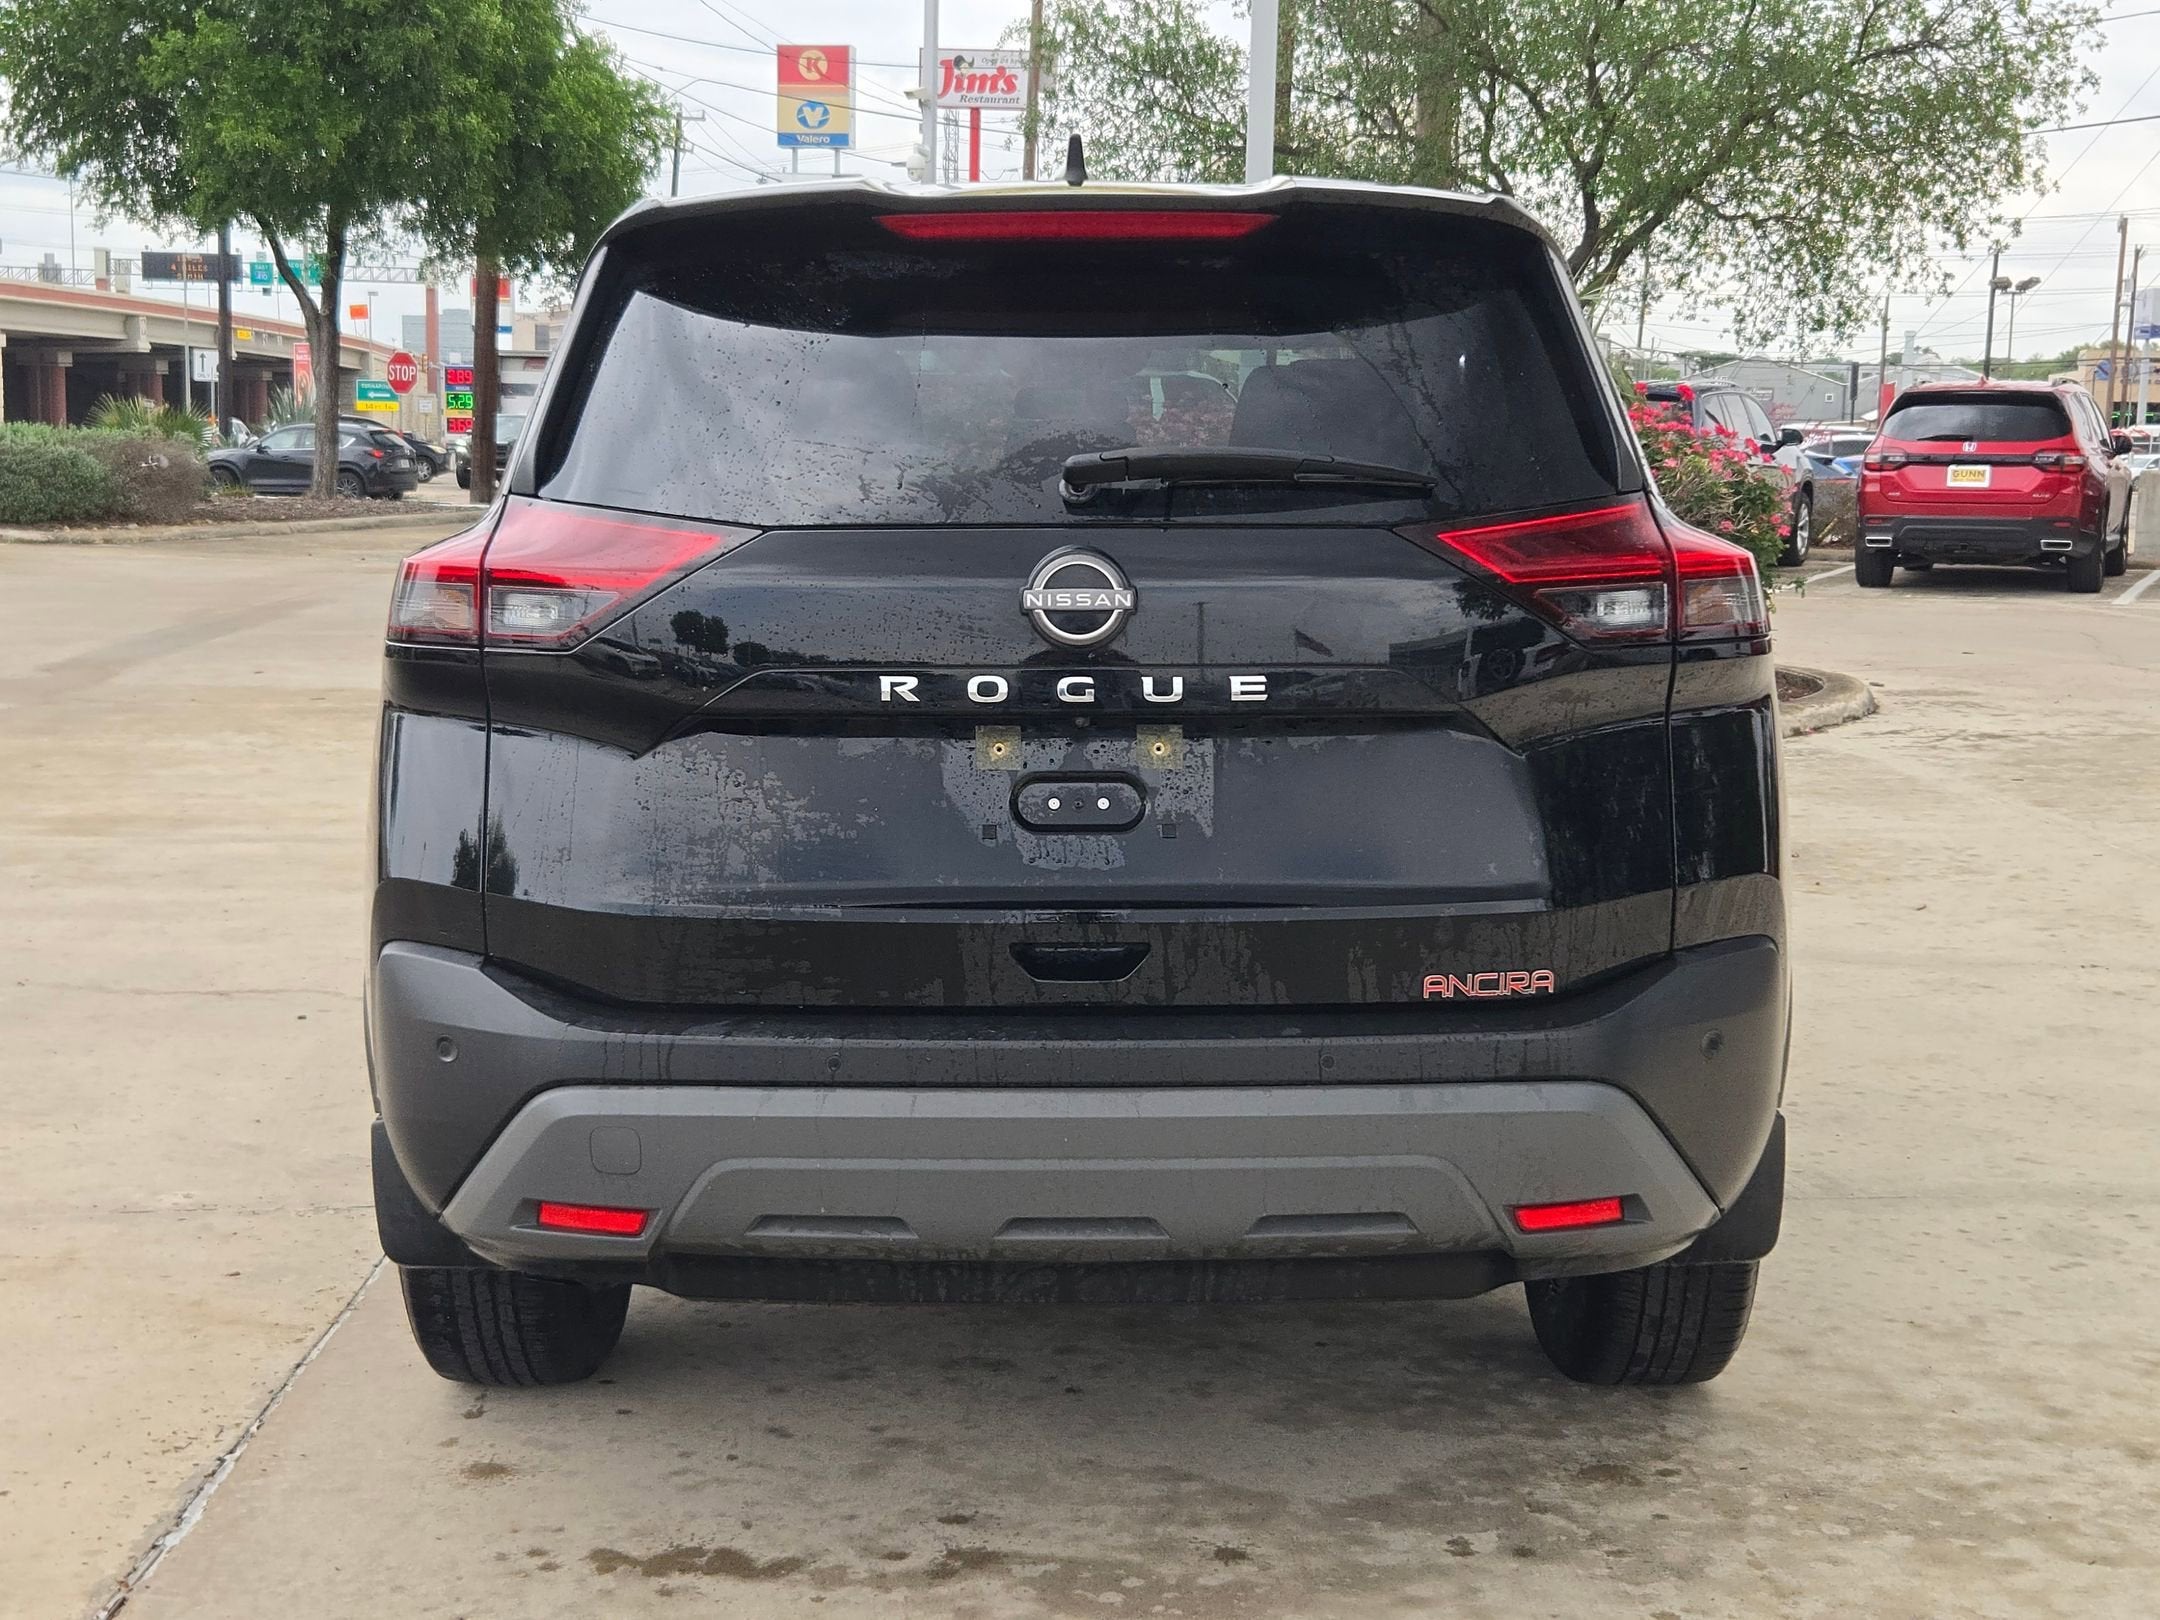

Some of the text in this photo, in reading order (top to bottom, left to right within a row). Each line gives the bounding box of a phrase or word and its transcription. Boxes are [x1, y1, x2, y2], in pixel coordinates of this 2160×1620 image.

[937, 58, 1019, 99] Jim's
[959, 94, 1021, 104] Restaurant
[796, 134, 831, 144] Valero
[388, 364, 417, 382] STOP
[448, 394, 473, 409] 5.29
[1952, 470, 1985, 478] GUNN
[1025, 590, 1133, 608] NISSAN
[878, 675, 1269, 703] ROGUE
[1422, 969, 1555, 999] ANCIRA
